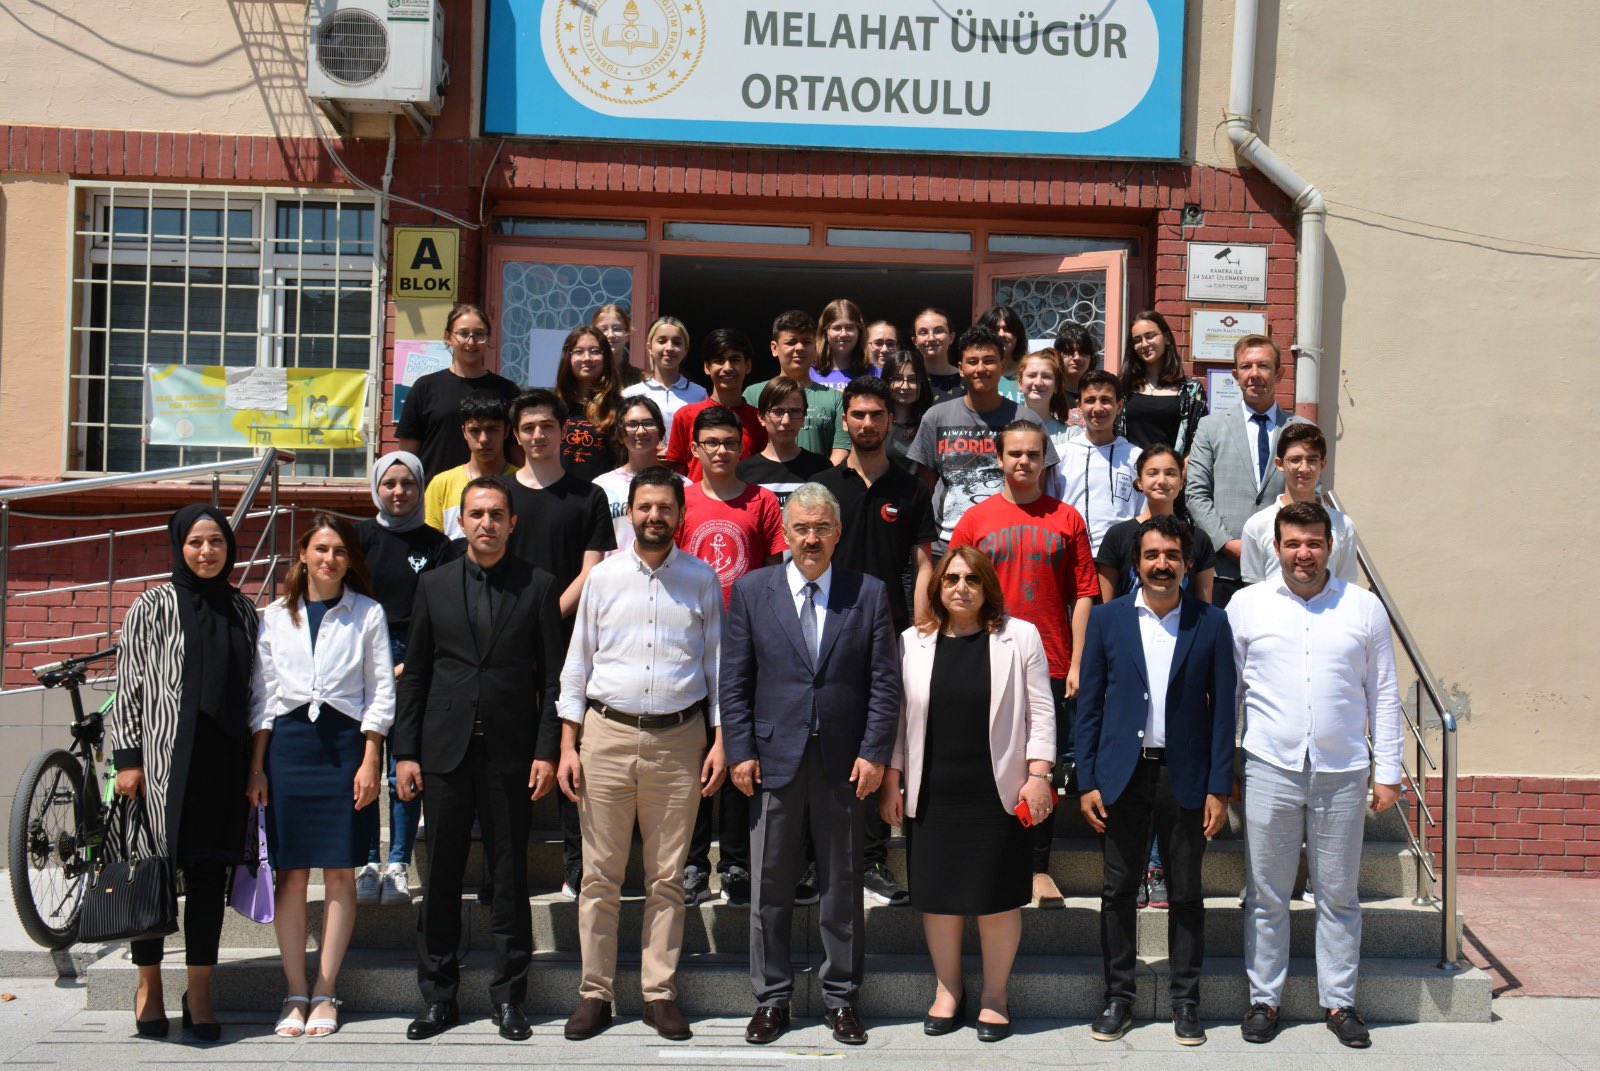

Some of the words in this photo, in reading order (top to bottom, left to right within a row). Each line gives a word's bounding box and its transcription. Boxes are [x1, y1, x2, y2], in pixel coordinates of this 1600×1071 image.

[743, 10, 940, 51] MELAHAT
[951, 9, 1128, 59] ÜNÜGÜR
[741, 73, 991, 116] ORTAOKULU
[410, 237, 442, 270] A
[400, 277, 451, 291] BLOK
[937, 437, 998, 455] FLORID
